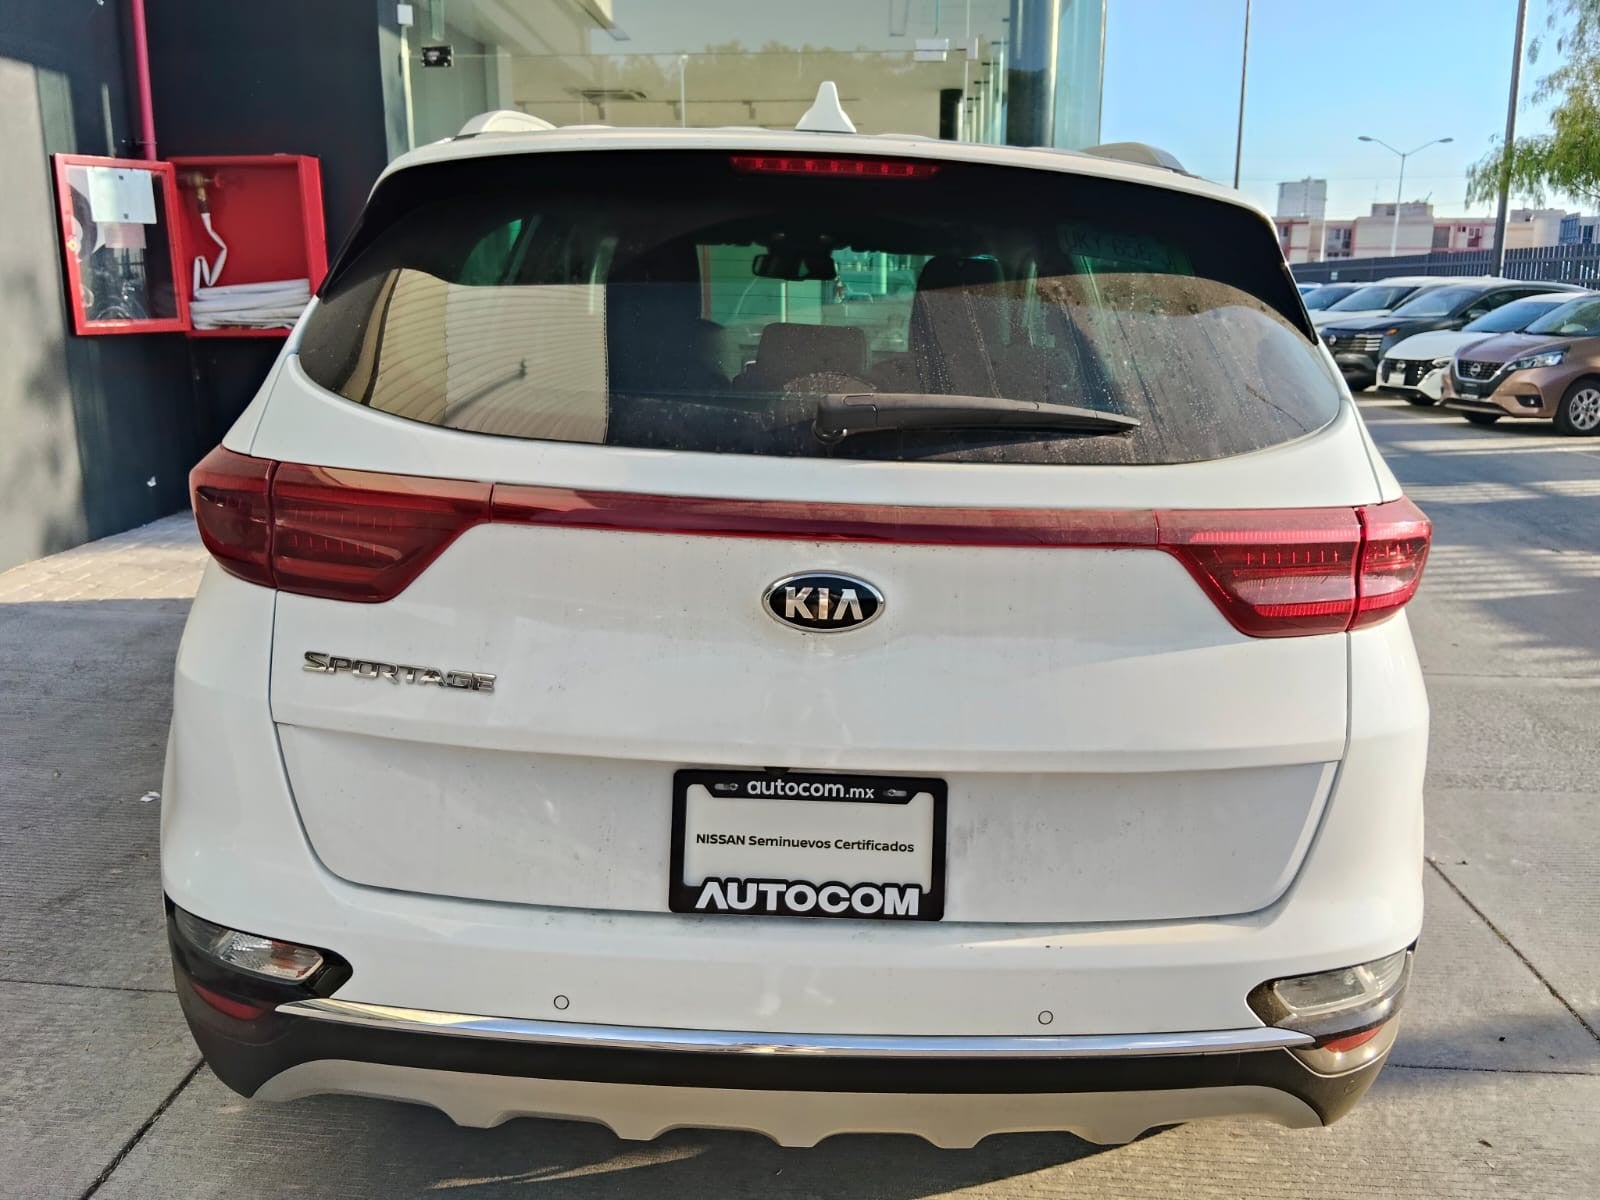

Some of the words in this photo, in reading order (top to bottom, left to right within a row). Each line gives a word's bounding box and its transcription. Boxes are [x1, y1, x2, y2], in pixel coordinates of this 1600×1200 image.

[784, 586, 864, 621] KIA
[303, 650, 497, 693] SPORTAGE
[746, 779, 875, 800] autocom.mx
[696, 833, 746, 846] NISSAN
[748, 835, 831, 849] Seminuevos
[834, 838, 915, 852] Certificados
[695, 881, 920, 916] AUTOCOM
